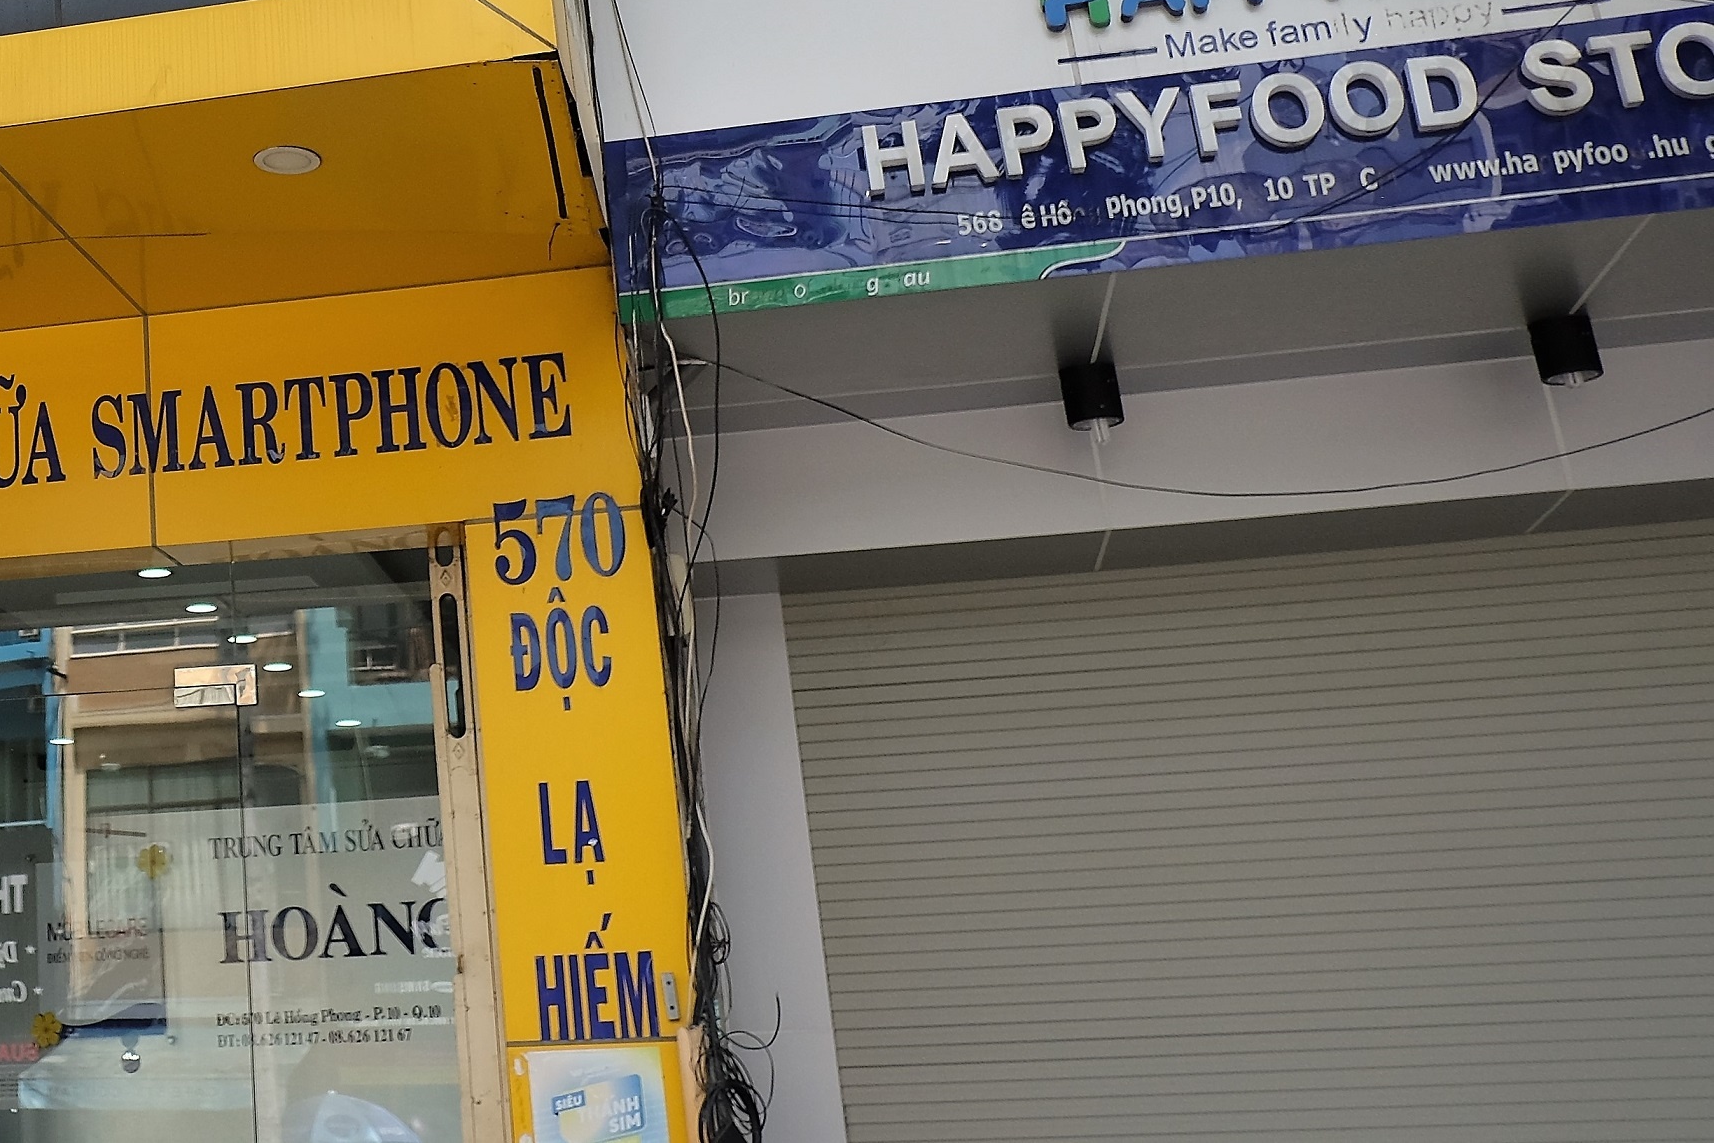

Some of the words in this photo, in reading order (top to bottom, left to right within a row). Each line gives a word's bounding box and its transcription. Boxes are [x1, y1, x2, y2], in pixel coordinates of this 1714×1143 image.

[1164, 26, 1258, 59] Make
[1266, 12, 1373, 46] family
[859, 54, 1479, 198] HAPPYFOOD
[957, 210, 1004, 235] 568
[1263, 176, 1294, 202] 10
[1302, 172, 1337, 198] TP
[91, 352, 572, 481] SMARTPHONE
[492, 491, 626, 587] 570
[510, 586, 613, 711] ĐỘC
[208, 834, 283, 860] TRUNG
[289, 826, 337, 855] TÂM
[344, 818, 385, 852] SỬA
[390, 817, 443, 850] CHỮ
[538, 779, 605, 886] LẠ
[536, 912, 660, 1041] HIẾM
[609, 1112, 642, 1134] SIM
